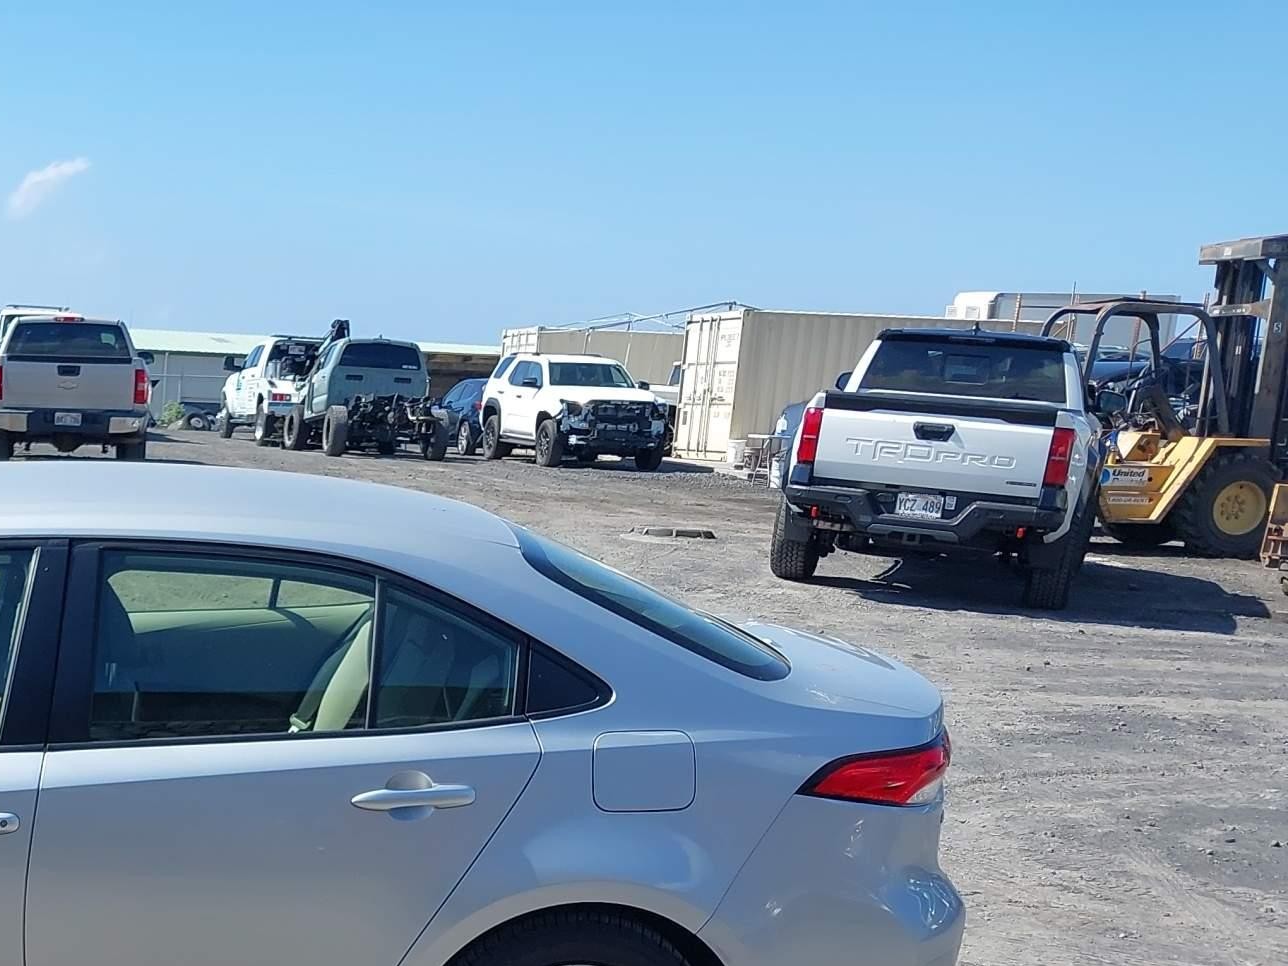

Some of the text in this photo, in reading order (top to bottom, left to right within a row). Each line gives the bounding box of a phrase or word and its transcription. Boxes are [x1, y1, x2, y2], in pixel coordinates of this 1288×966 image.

[1112, 468, 1146, 478] United
[898, 497, 917, 512] YCZ
[922, 499, 942, 514] 489
